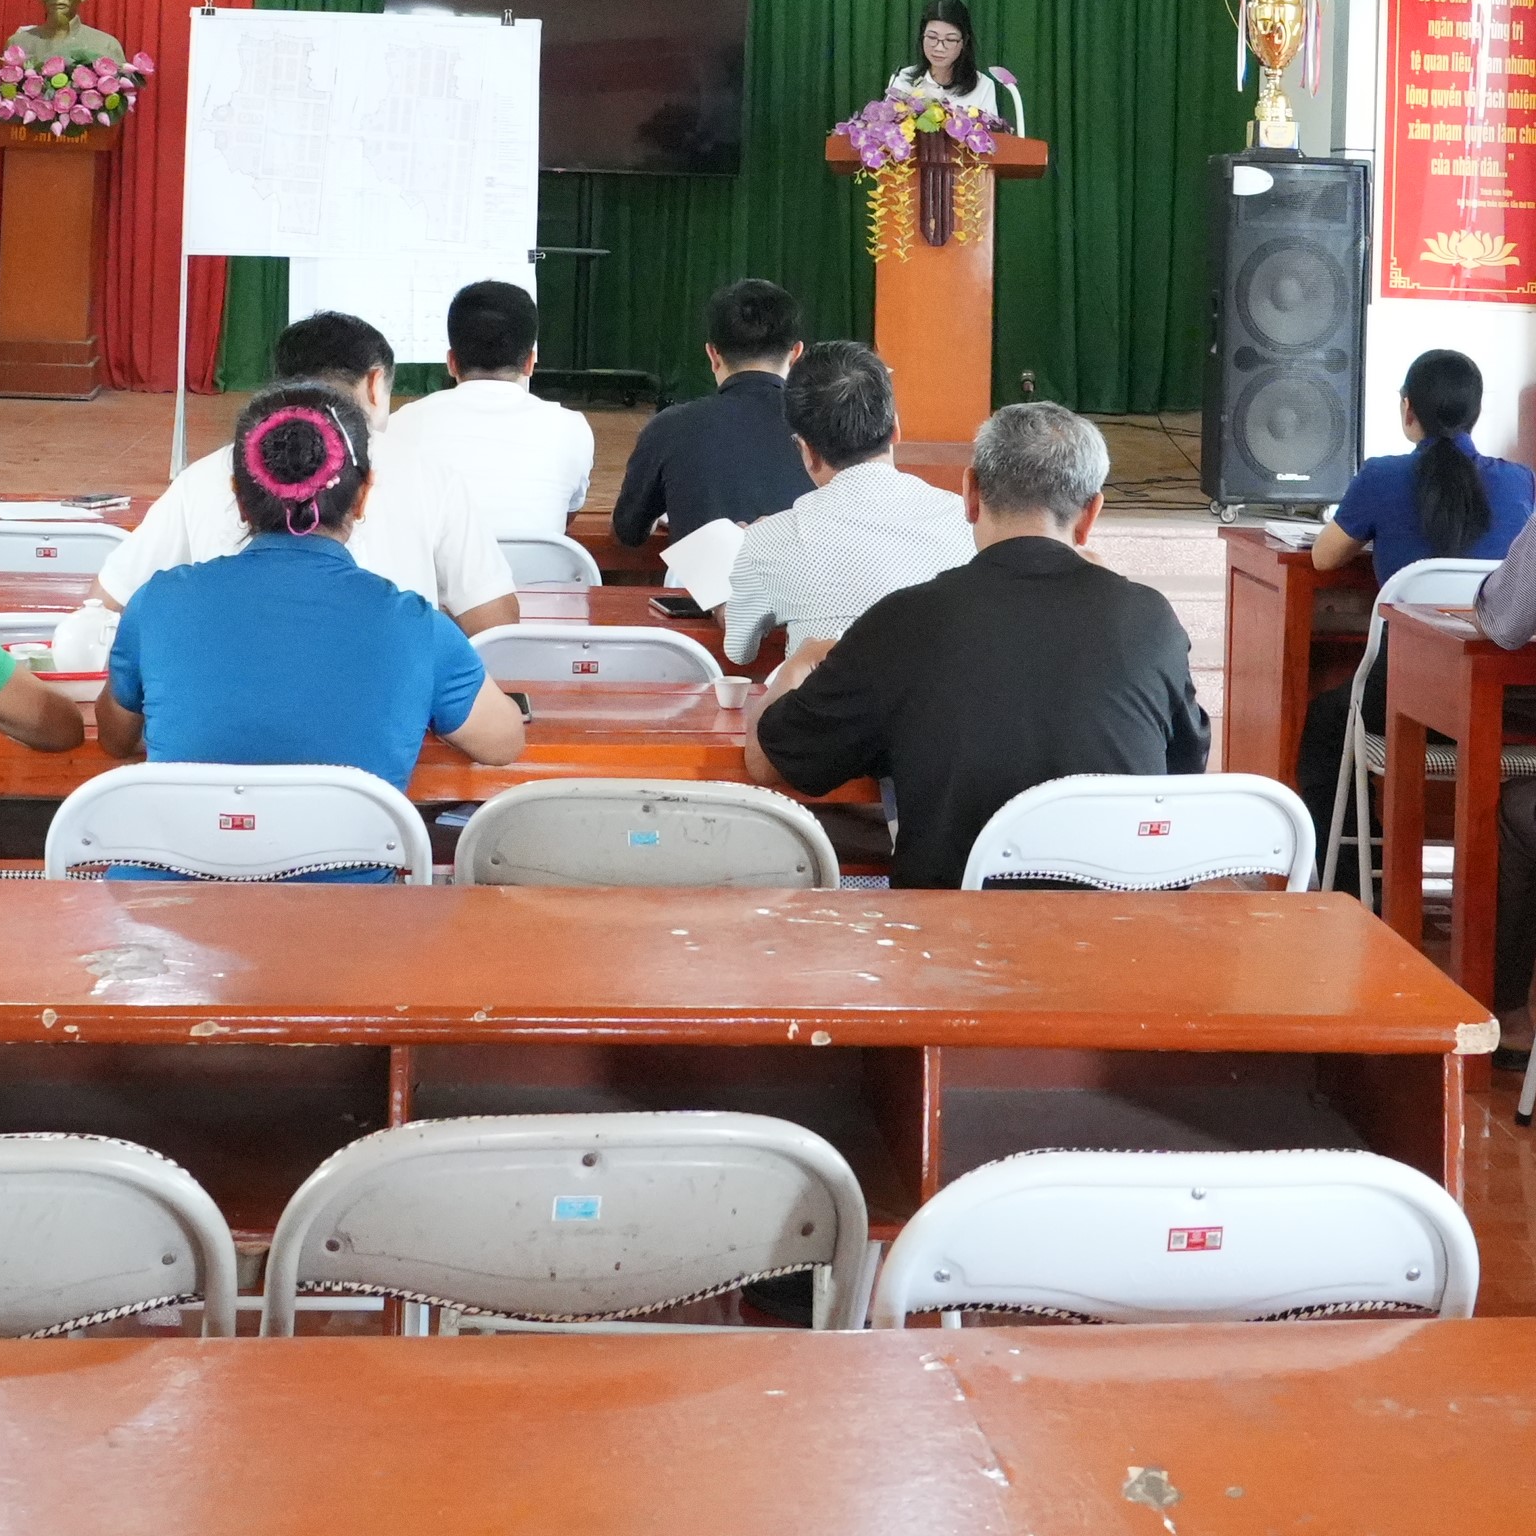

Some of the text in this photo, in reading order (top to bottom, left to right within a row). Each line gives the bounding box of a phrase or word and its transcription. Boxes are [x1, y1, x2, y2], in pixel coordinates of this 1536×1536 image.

[1428, 17, 1454, 39] ngăn
[1411, 50, 1421, 75] tệ
[1423, 53, 1449, 73] quan
[1406, 84, 1428, 109] lộng
[1408, 119, 1431, 140] xâm
[1433, 120, 1462, 146] phạm
[1498, 123, 1516, 144] làm
[1431, 152, 1450, 175] của
[1453, 156, 1478, 177] nhân
